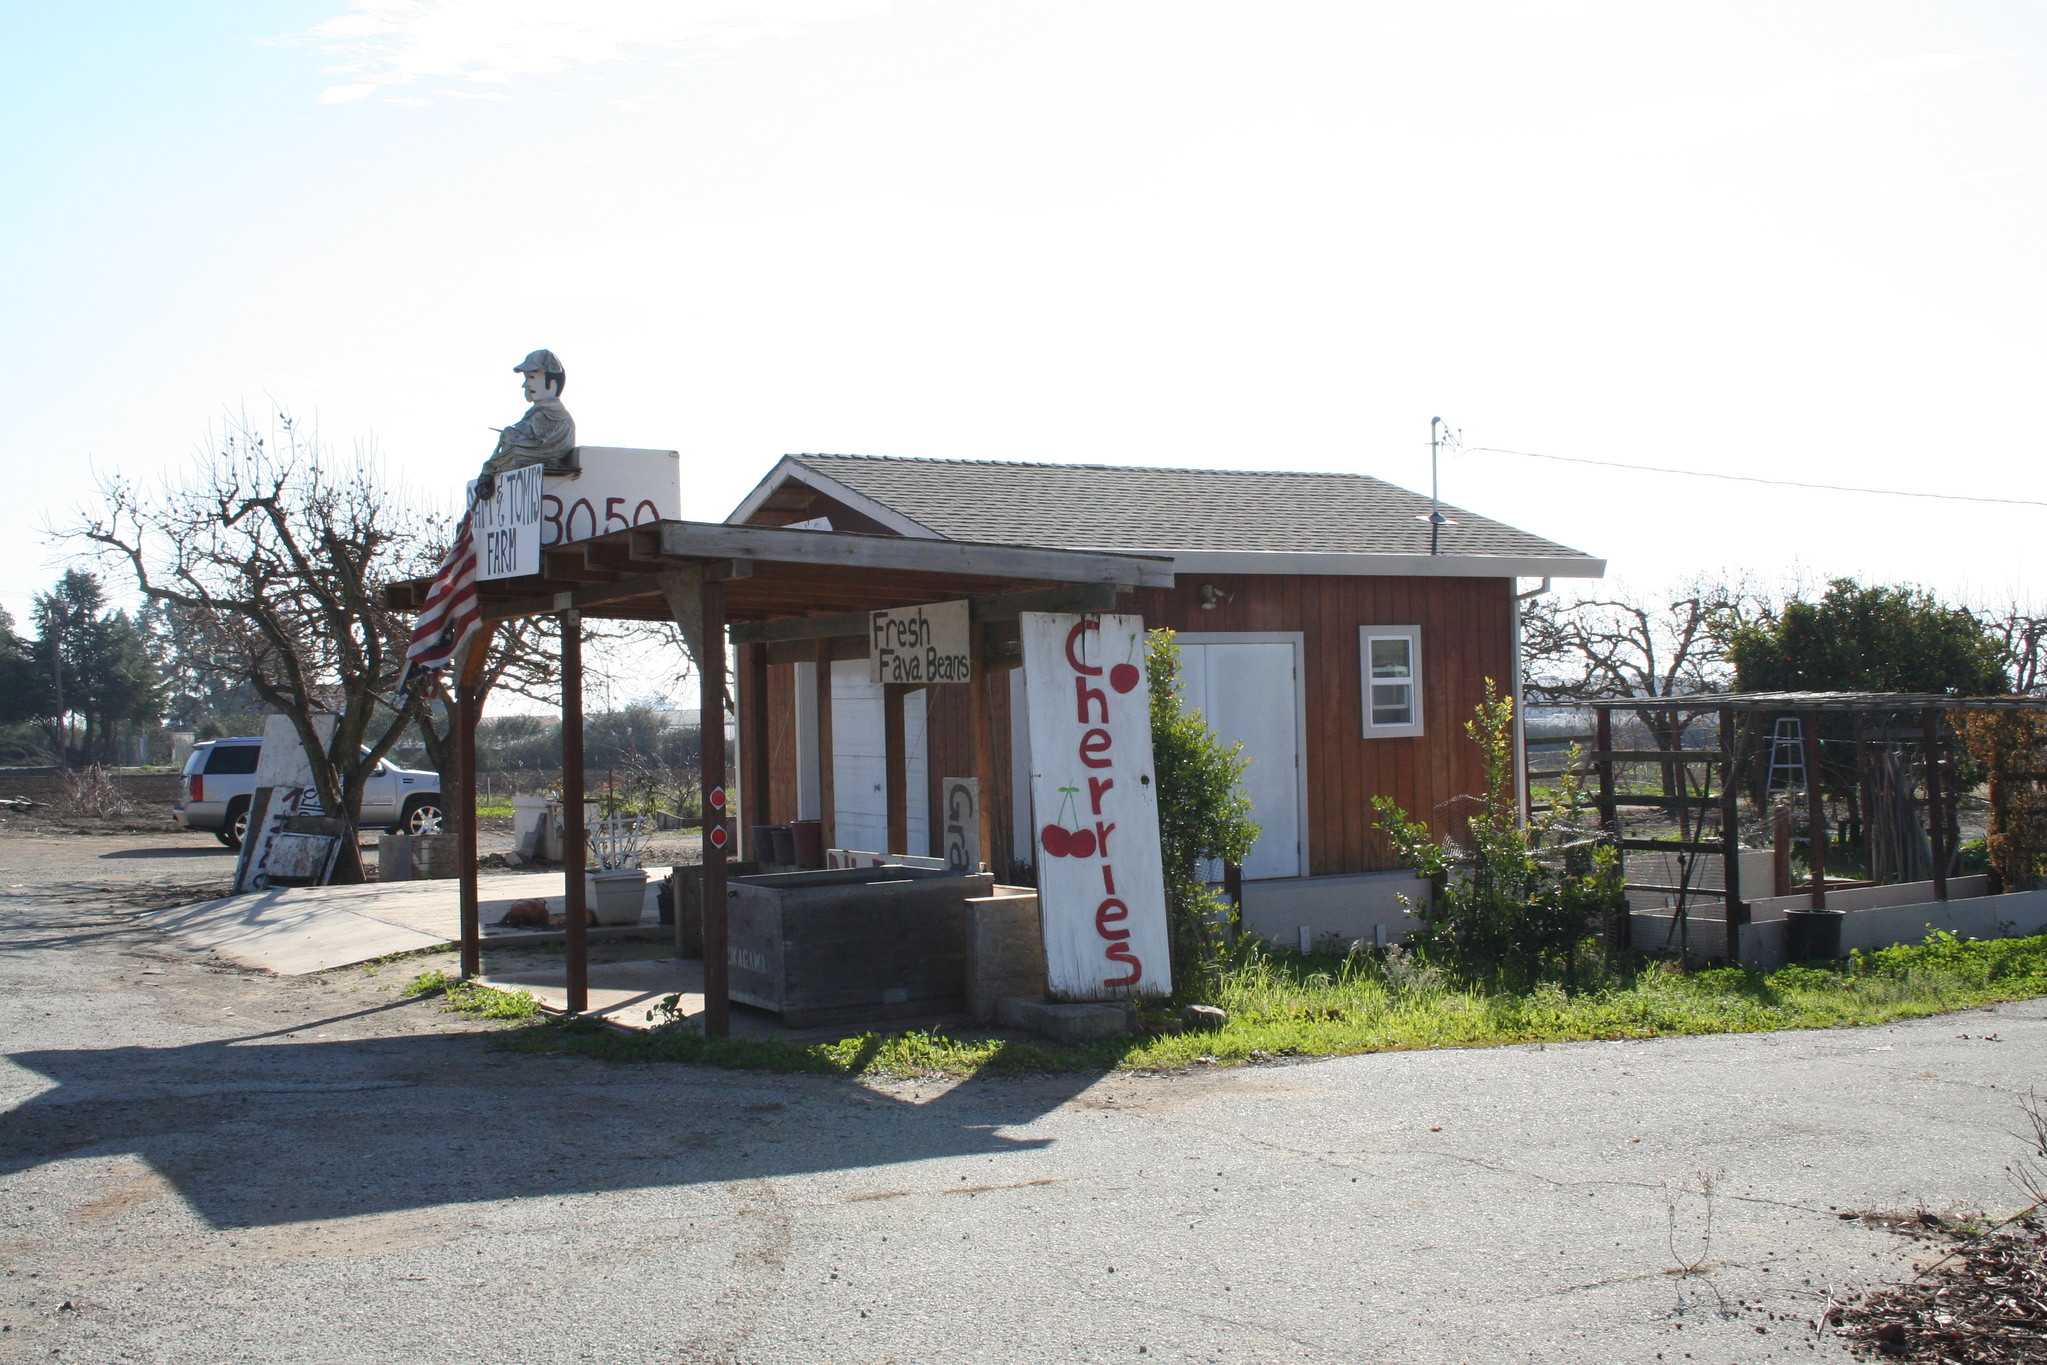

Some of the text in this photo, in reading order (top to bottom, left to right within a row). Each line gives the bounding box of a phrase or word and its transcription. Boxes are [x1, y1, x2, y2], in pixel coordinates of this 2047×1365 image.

[496, 474, 505, 527] &
[487, 528, 517, 575] FARM
[873, 608, 931, 648] Fresh
[880, 646, 970, 682] Fava Beans
[1065, 619, 1142, 987] Cherries
